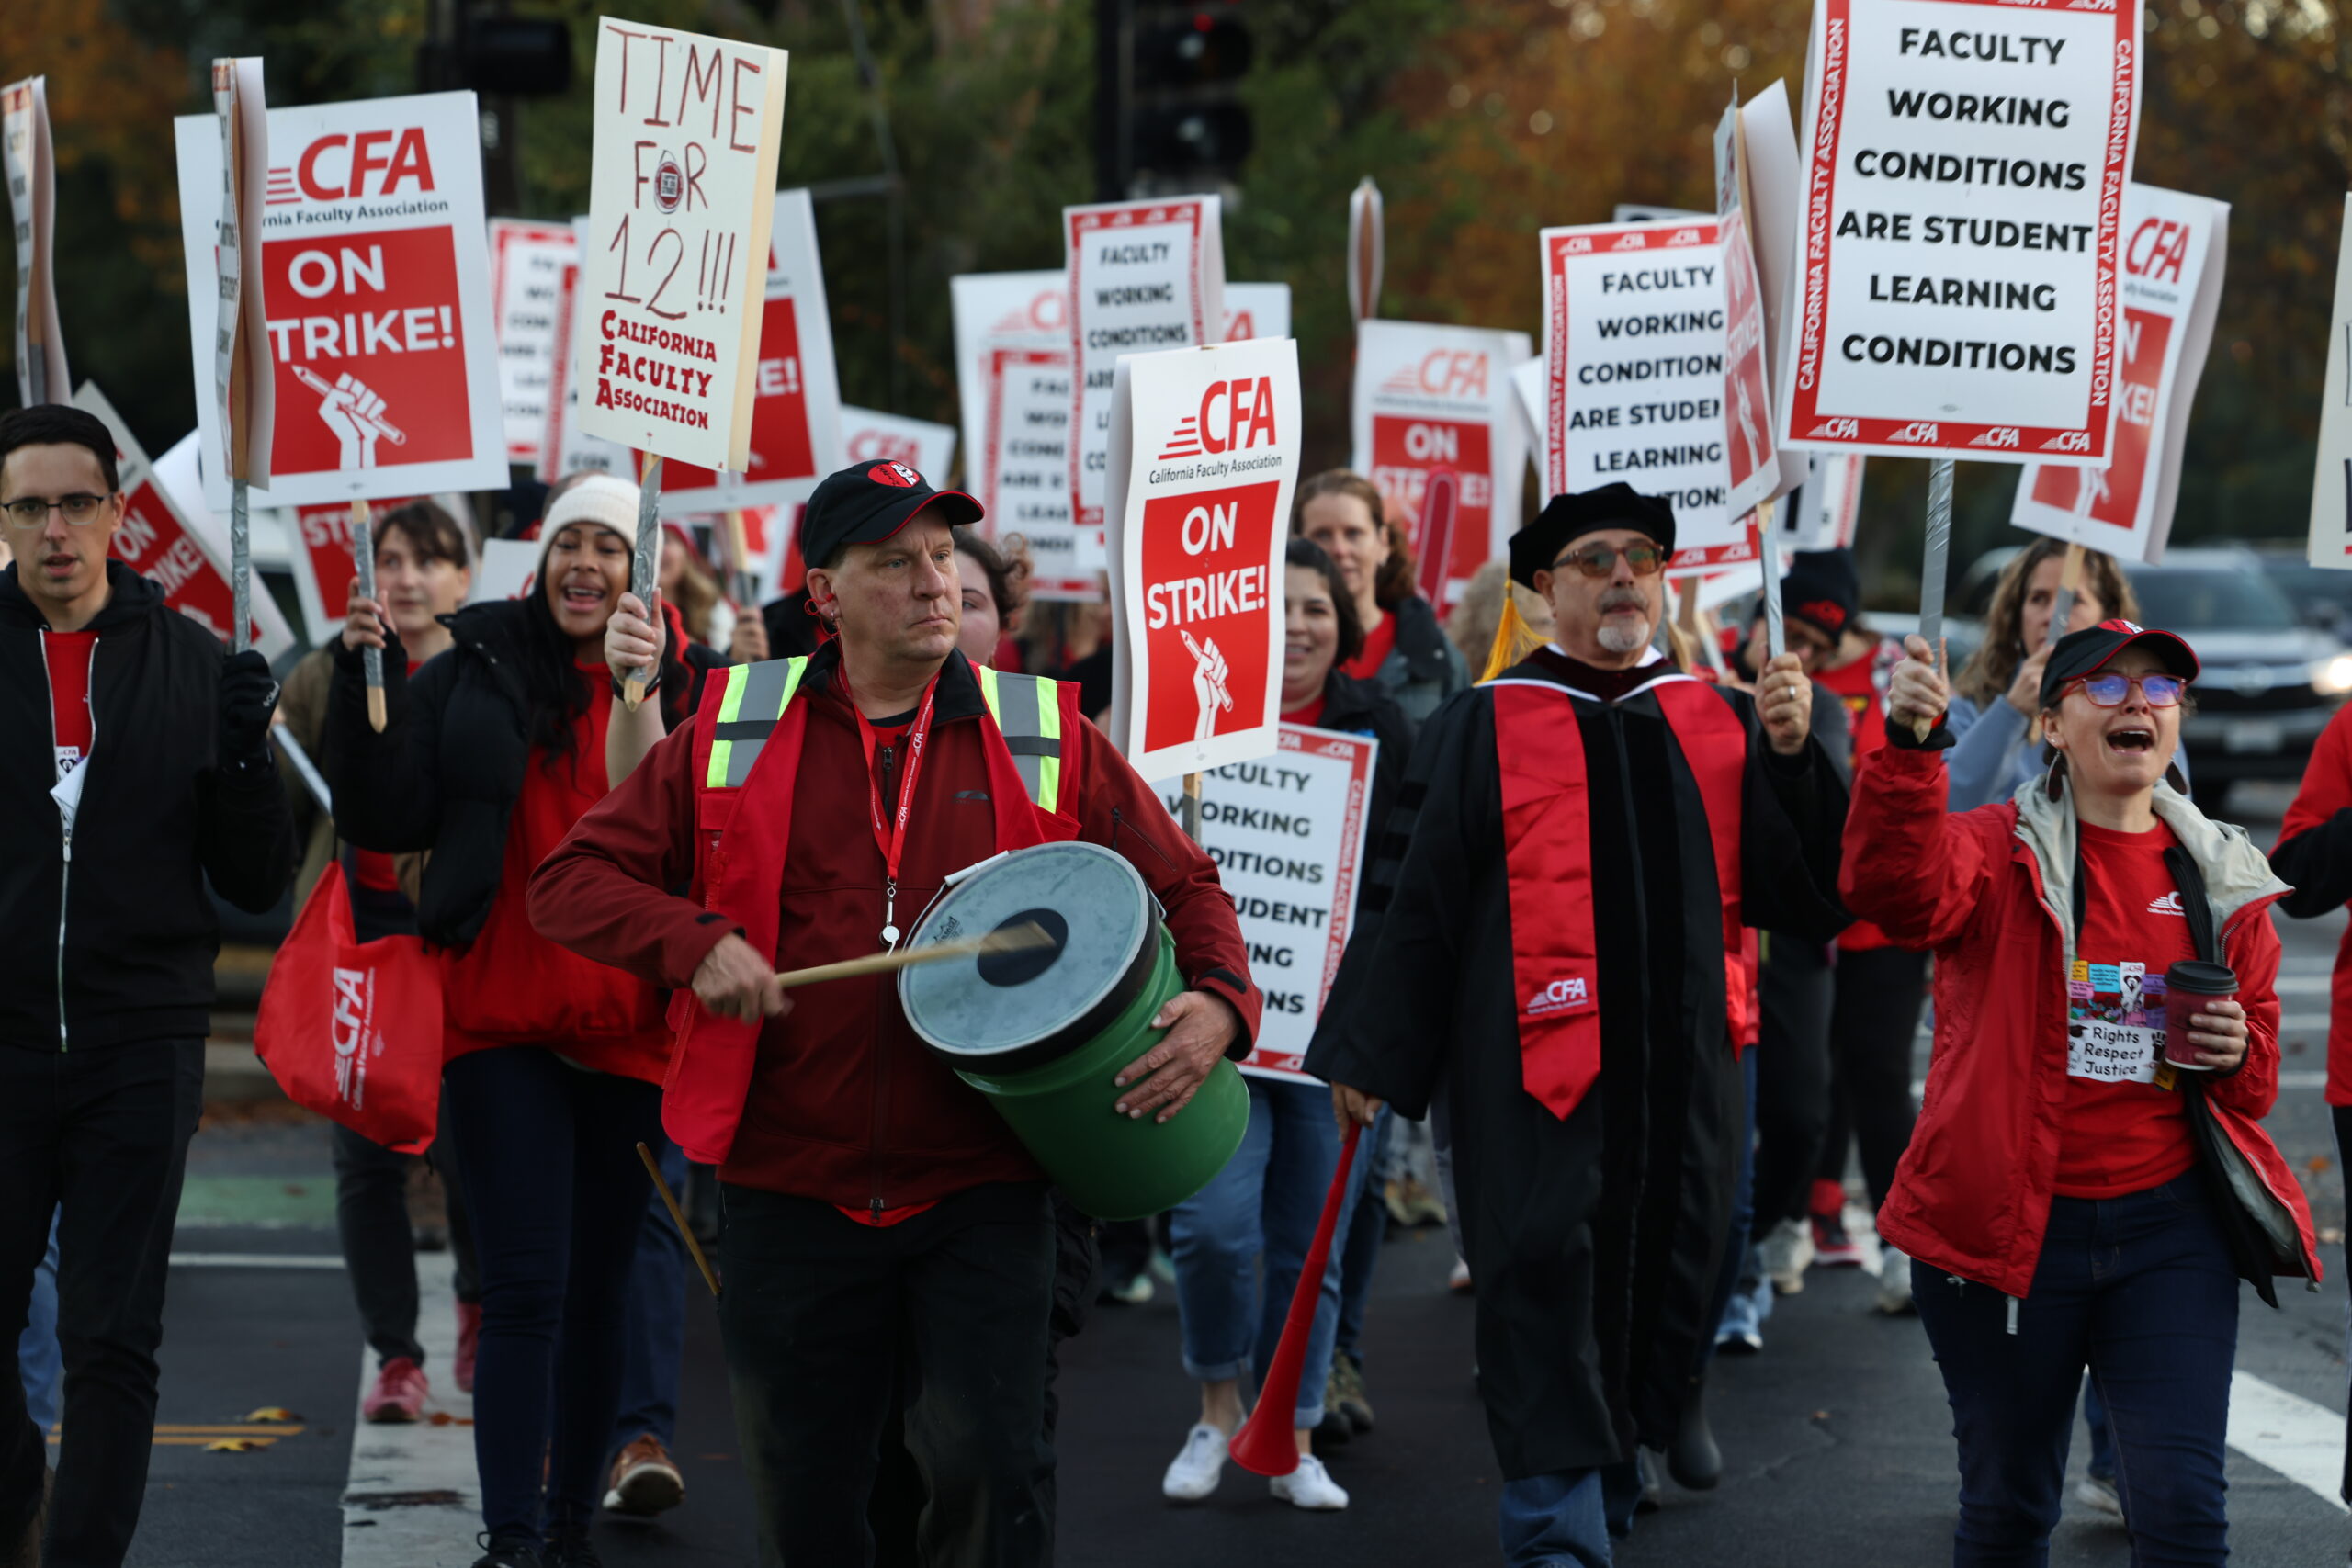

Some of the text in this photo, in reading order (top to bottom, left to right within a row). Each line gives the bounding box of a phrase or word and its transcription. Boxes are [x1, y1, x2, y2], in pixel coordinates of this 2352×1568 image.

[1900, 28, 2066, 65] FACULTY
[605, 25, 761, 154] TIME
[1887, 89, 2070, 128] WORKING
[297, 127, 435, 202] CFA
[1854, 149, 2086, 191] CONDITIONS
[297, 207, 354, 225] Faculty
[357, 200, 449, 220] Association
[1798, 18, 1845, 391] CALIFORNIA FACULTY ASSOCIATION
[2091, 39, 2133, 407] CALIFORNIA FACULTY ASSOCIATION
[1836, 210, 2093, 253] ARE STUDENT
[2125, 217, 2191, 284] CFA
[288, 244, 386, 299] ON
[605, 214, 735, 320] 12!!!
[1100, 242, 1171, 265] FACULTY
[1095, 283, 1174, 307] WORKING
[1602, 266, 1714, 294] FACULTY
[1869, 274, 2057, 311] LEARNING
[266, 305, 455, 363] TRIKE!
[601, 310, 717, 363] CALIFORNIA
[1088, 323, 1187, 350] CONDITIONS
[1598, 310, 1724, 339] WORKING
[2122, 318, 2142, 365] N
[599, 344, 713, 398] FACULTY
[1419, 348, 1488, 399] CFA
[1578, 354, 1723, 385] CONDITION
[1842, 334, 2075, 374] CONDITIONS
[595, 378, 708, 430] ASSOCIATION
[1200, 376, 1276, 455] CFA
[1569, 407, 1620, 430] ARE
[1405, 423, 1459, 462] ON
[1825, 419, 1859, 438] CFA
[1905, 423, 1938, 443] CFA
[1985, 427, 2019, 447] CFA
[2057, 432, 2090, 451] CFA
[1149, 454, 1282, 485] California Faculty Association
[1594, 443, 1722, 472] LEARNING
[113, 508, 158, 562] ON
[1182, 501, 1238, 557] ON
[1147, 565, 1266, 630] STRIKE!
[913, 732, 924, 749] CFA
[899, 806, 908, 823] CFA
[1205, 846, 1324, 885] DITIONS
[1234, 896, 1329, 930] UDENT
[1545, 977, 1588, 1002] CFA
[332, 967, 364, 1056] CFA
[2085, 1043, 2144, 1061] Respect
[2093, 1027, 2140, 1045] Rights
[2085, 1061, 2138, 1076] Justice
